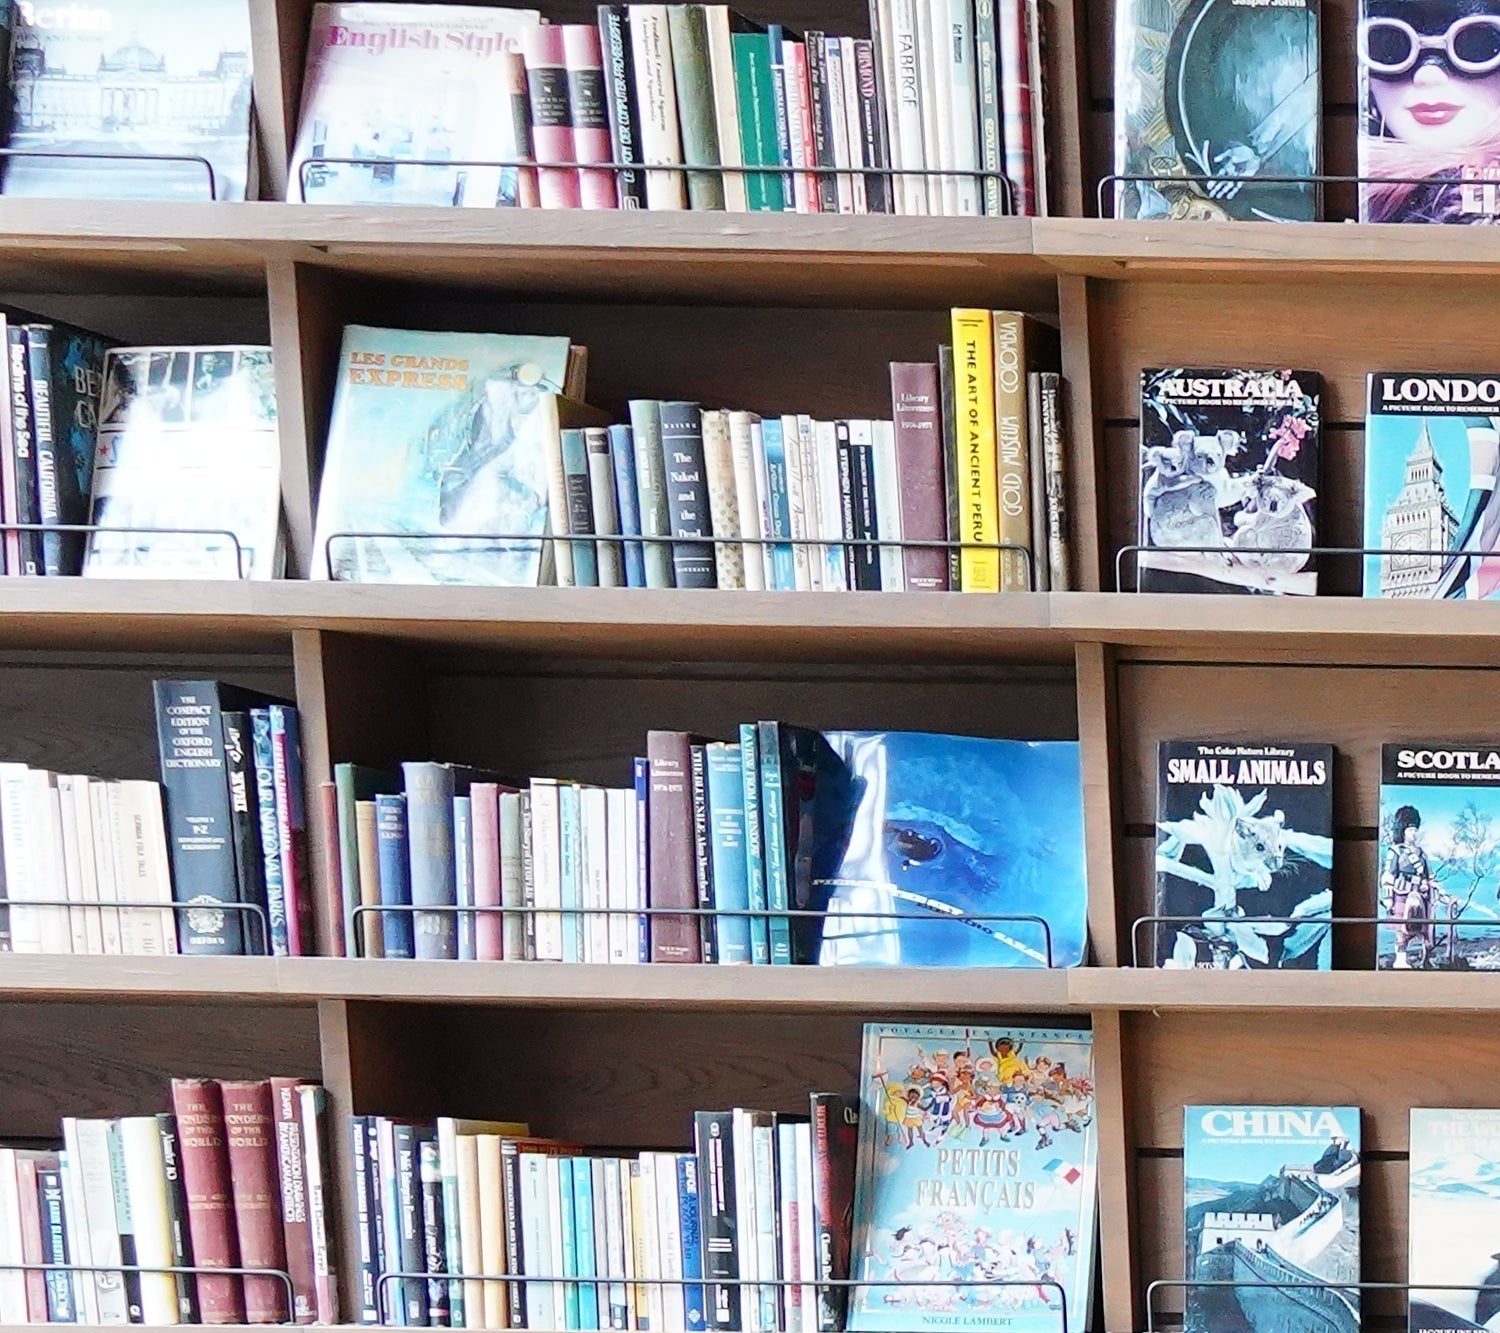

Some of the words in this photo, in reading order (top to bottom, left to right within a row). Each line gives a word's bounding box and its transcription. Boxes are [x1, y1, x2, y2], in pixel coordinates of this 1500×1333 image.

[1159, 378, 1304, 400] AUSTRALIA
[1166, 759, 1236, 785] SMALL
[1238, 760, 1326, 786] ANIMALS
[1200, 1109, 1340, 1138] CHINA
[936, 1147, 1019, 1177] PETITS
[918, 1180, 1036, 1214] FRANÇAIS
